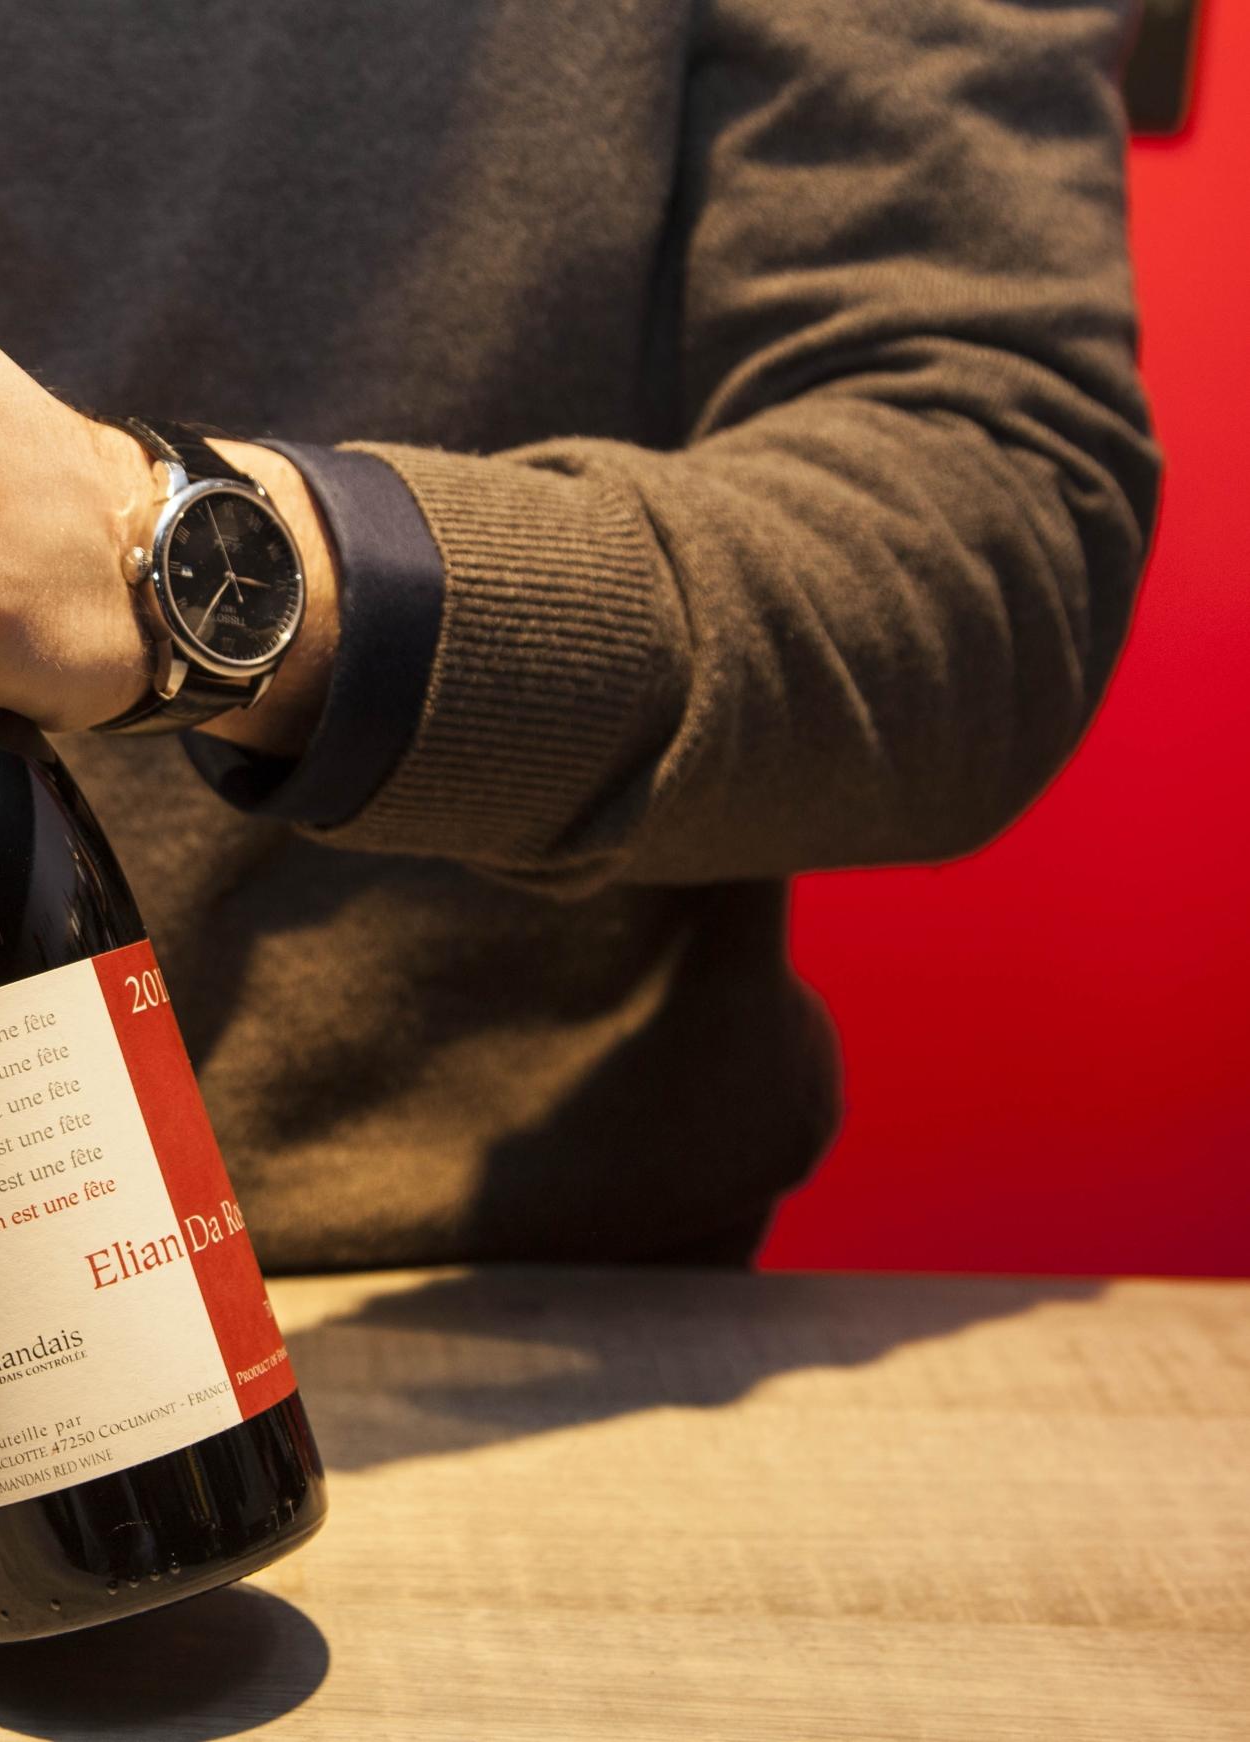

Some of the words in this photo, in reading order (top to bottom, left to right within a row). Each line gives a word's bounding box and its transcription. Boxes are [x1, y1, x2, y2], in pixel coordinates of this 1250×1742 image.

[24, 1013, 55, 1033] fête
[37, 1046, 69, 1066] fête
[7, 1093, 43, 1113] une
[49, 1080, 81, 1100] fête
[18, 1127, 54, 1147] une
[60, 1114, 91, 1134] fête
[30, 1161, 65, 1181] une
[71, 1148, 102, 1168] fête
[12, 1205, 39, 1224] est
[43, 1193, 78, 1214] une
[84, 1180, 115, 1200] fête
[85, 1235, 183, 1289] Elian
[185, 1215, 223, 1252] Da
[55, 1416, 81, 1436] par
[52, 1431, 94, 1454] 47250
[53, 1461, 77, 1477] RED
[79, 1449, 113, 1468] WINE
